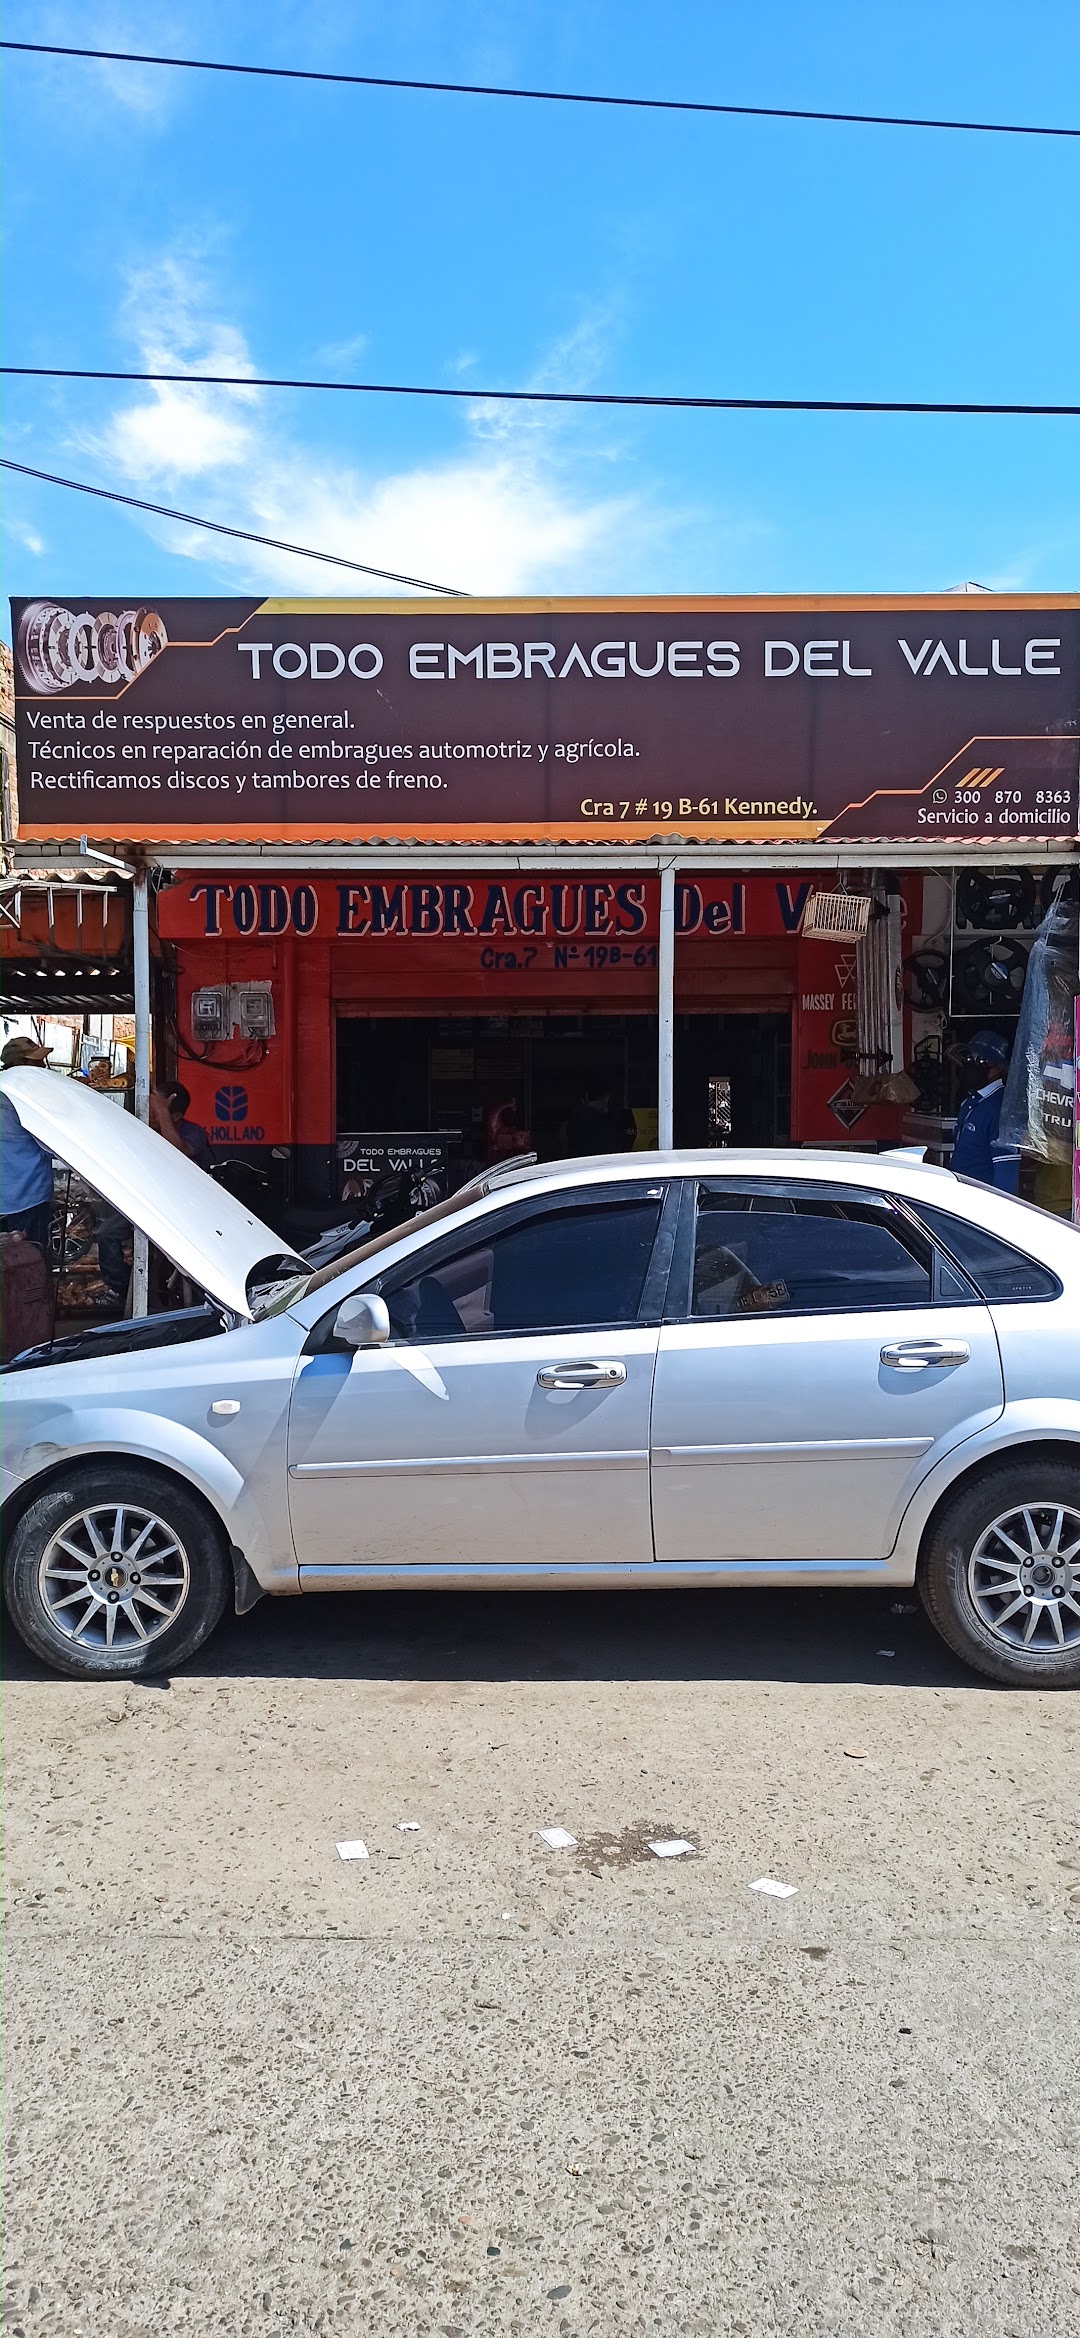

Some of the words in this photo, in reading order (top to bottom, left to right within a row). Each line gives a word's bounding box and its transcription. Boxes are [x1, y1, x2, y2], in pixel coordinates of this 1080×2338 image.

[237, 642, 384, 680] TODO
[409, 640, 741, 680] EMBRAGUES
[764, 640, 872, 677] DEL
[897, 638, 1062, 676] VALLE
[26, 711, 86, 729] Venta
[91, 709, 117, 729] de
[123, 712, 236, 735] respuestos
[241, 715, 266, 729] en
[272, 709, 356, 735] general.
[28, 740, 116, 759] Técnicos
[121, 745, 147, 759] en
[152, 740, 262, 765] reparación
[267, 739, 293, 759] de
[298, 739, 414, 765] embragues
[418, 740, 533, 759] automotriz
[537, 744, 549, 763] y
[554, 738, 640, 764] agrícola.
[30, 769, 162, 789] Rectificamos
[167, 770, 230, 789] discos
[235, 775, 247, 794] y
[251, 769, 351, 789] tambores
[355, 769, 381, 789] de
[385, 769, 449, 789] freno.
[953, 790, 981, 804] 300
[994, 790, 1022, 804] 870
[1035, 790, 1071, 804] 8363
[580, 798, 614, 816] Cra
[619, 801, 631, 819] 7
[634, 798, 648, 815] #
[652, 801, 674, 820] 19
[679, 798, 719, 815] B-61
[724, 796, 819, 819] Kennedy.
[917, 807, 979, 824] Servicio
[983, 812, 993, 824] a
[998, 808, 1071, 824] domicilio
[188, 884, 319, 937] TODO
[336, 883, 647, 937] EMBRAGUES
[673, 882, 747, 936] Del
[802, 993, 835, 1011] MASSEY
[210, 1126, 265, 1141] HOLLAND
[360, 1148, 385, 1156] TODO
[387, 1148, 442, 1156] EMBRAGUES
[343, 1158, 381, 1172] DEL
